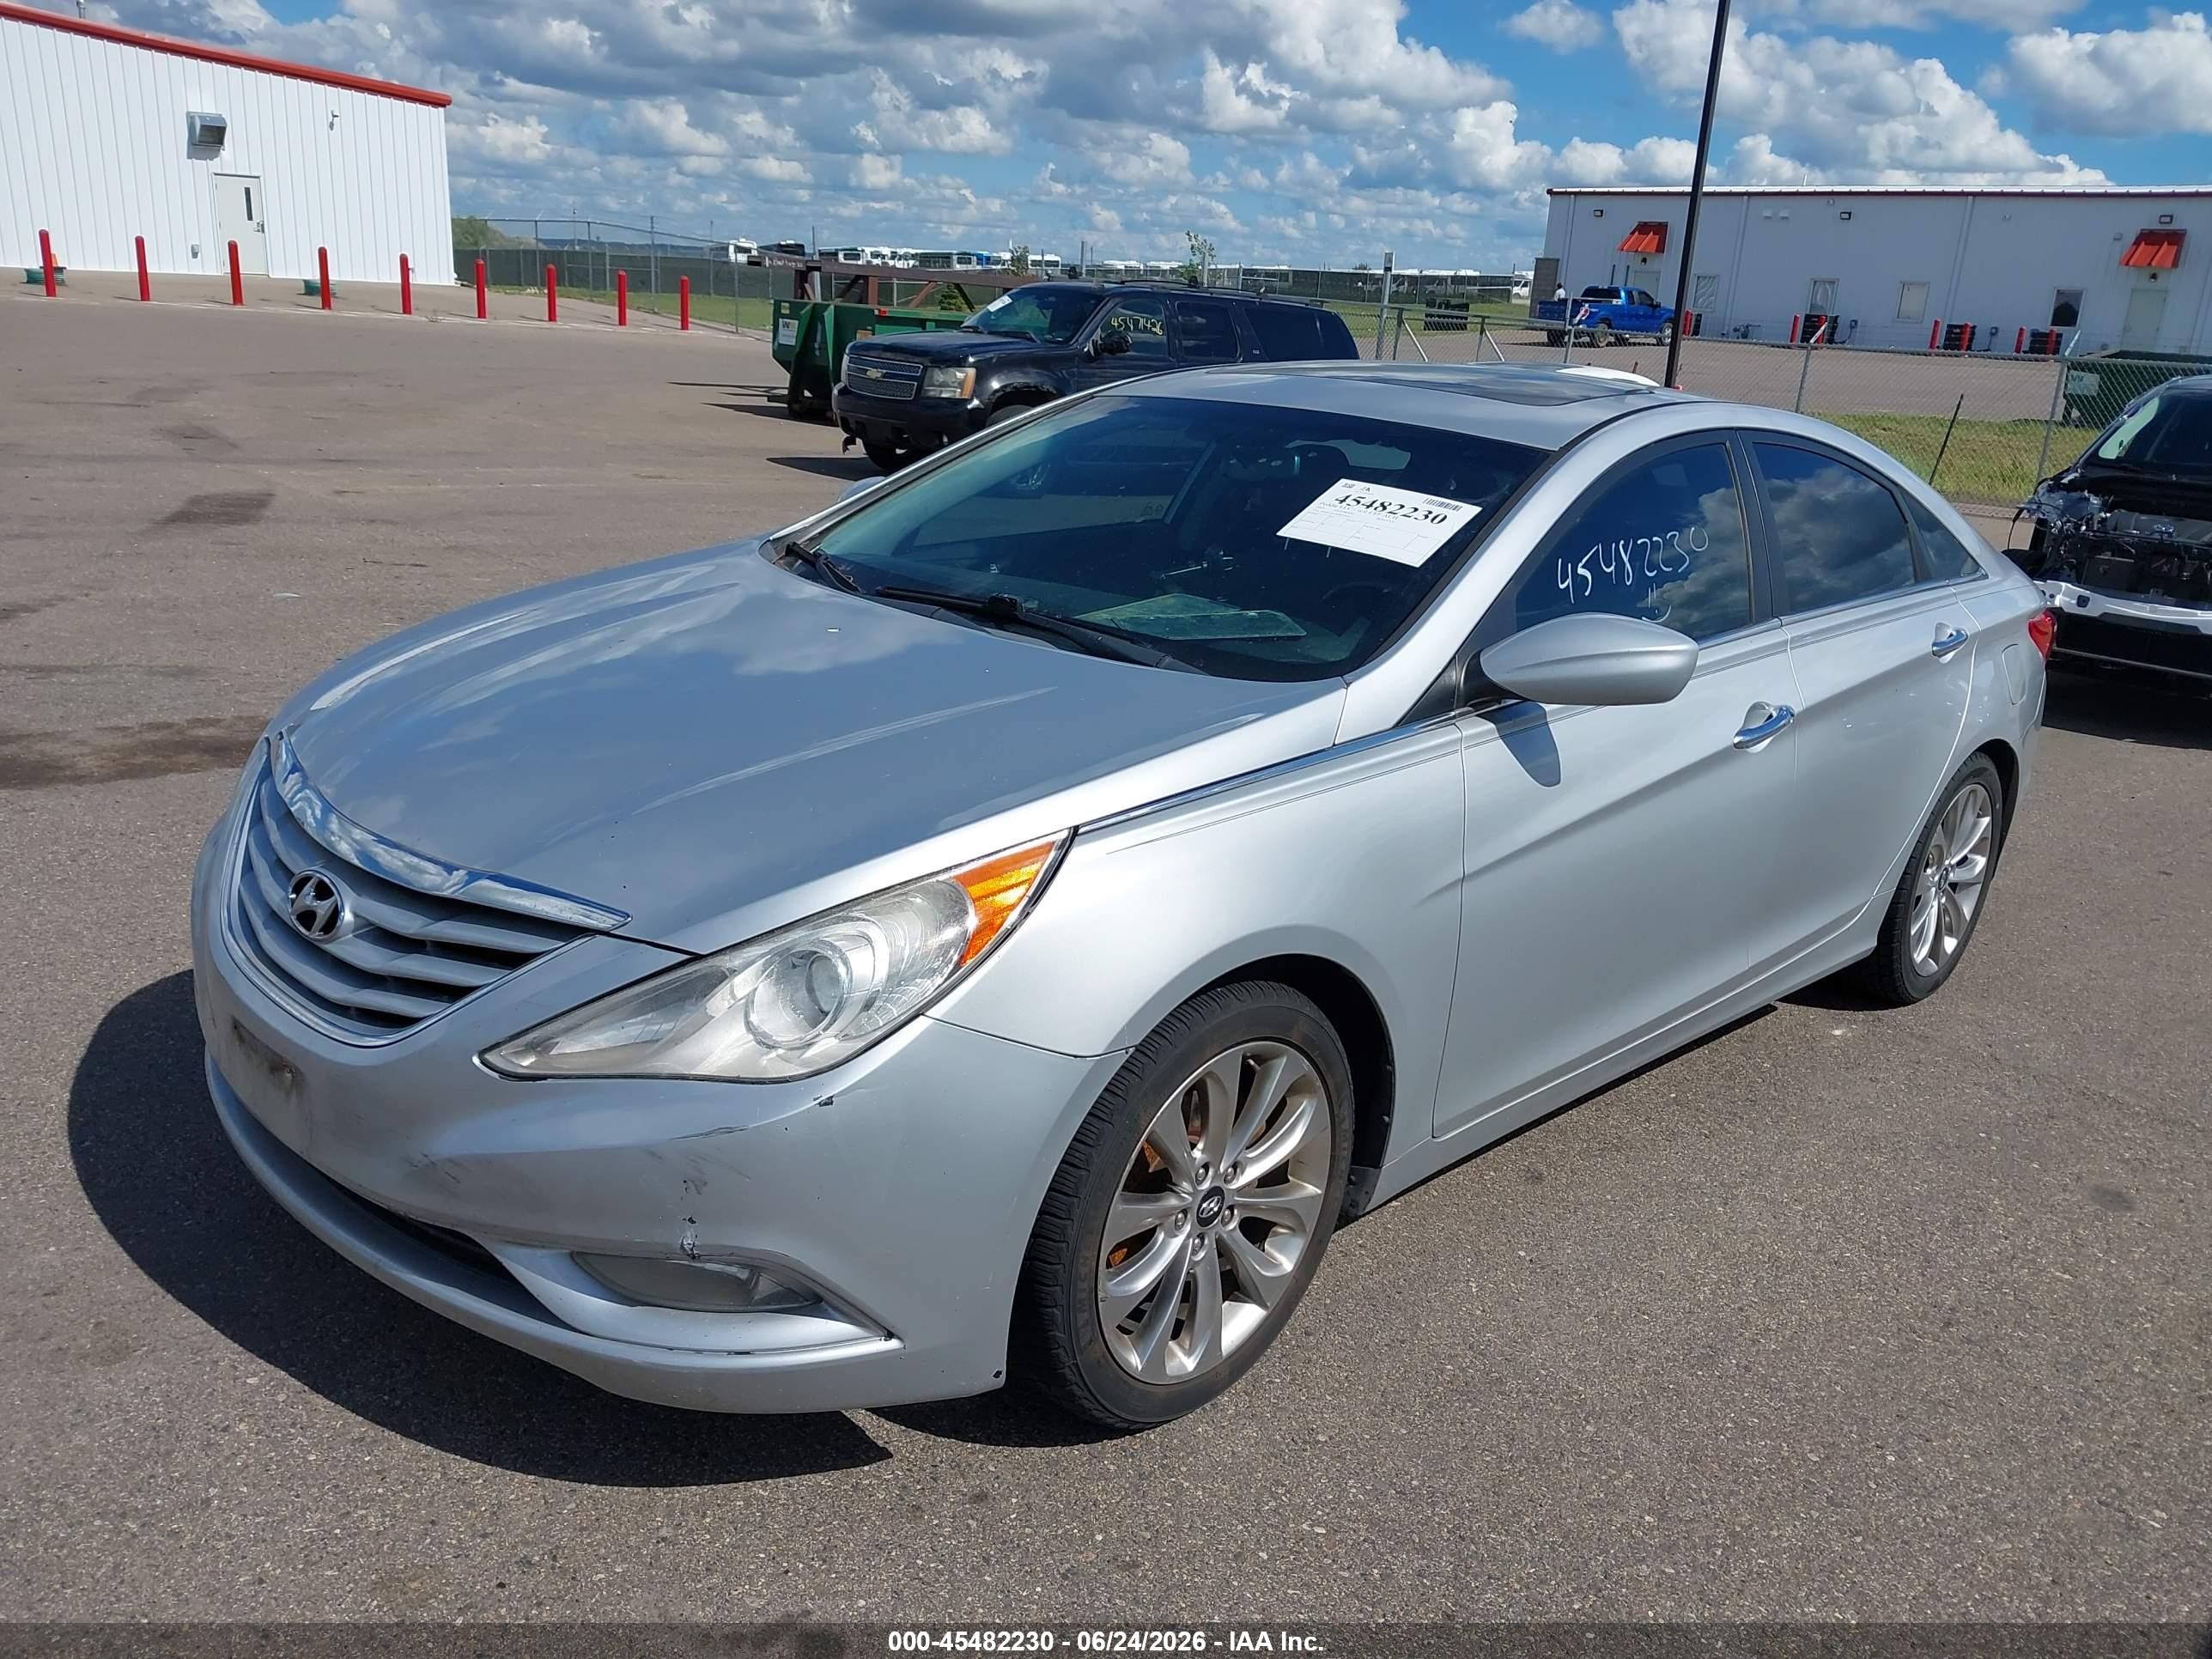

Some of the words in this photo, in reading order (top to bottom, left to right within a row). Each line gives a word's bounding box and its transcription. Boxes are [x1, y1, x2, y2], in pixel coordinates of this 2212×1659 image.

[1111, 315, 1164, 336] 45471426
[1334, 494, 1448, 525] 45482230
[1557, 526, 1710, 605] 45482230
